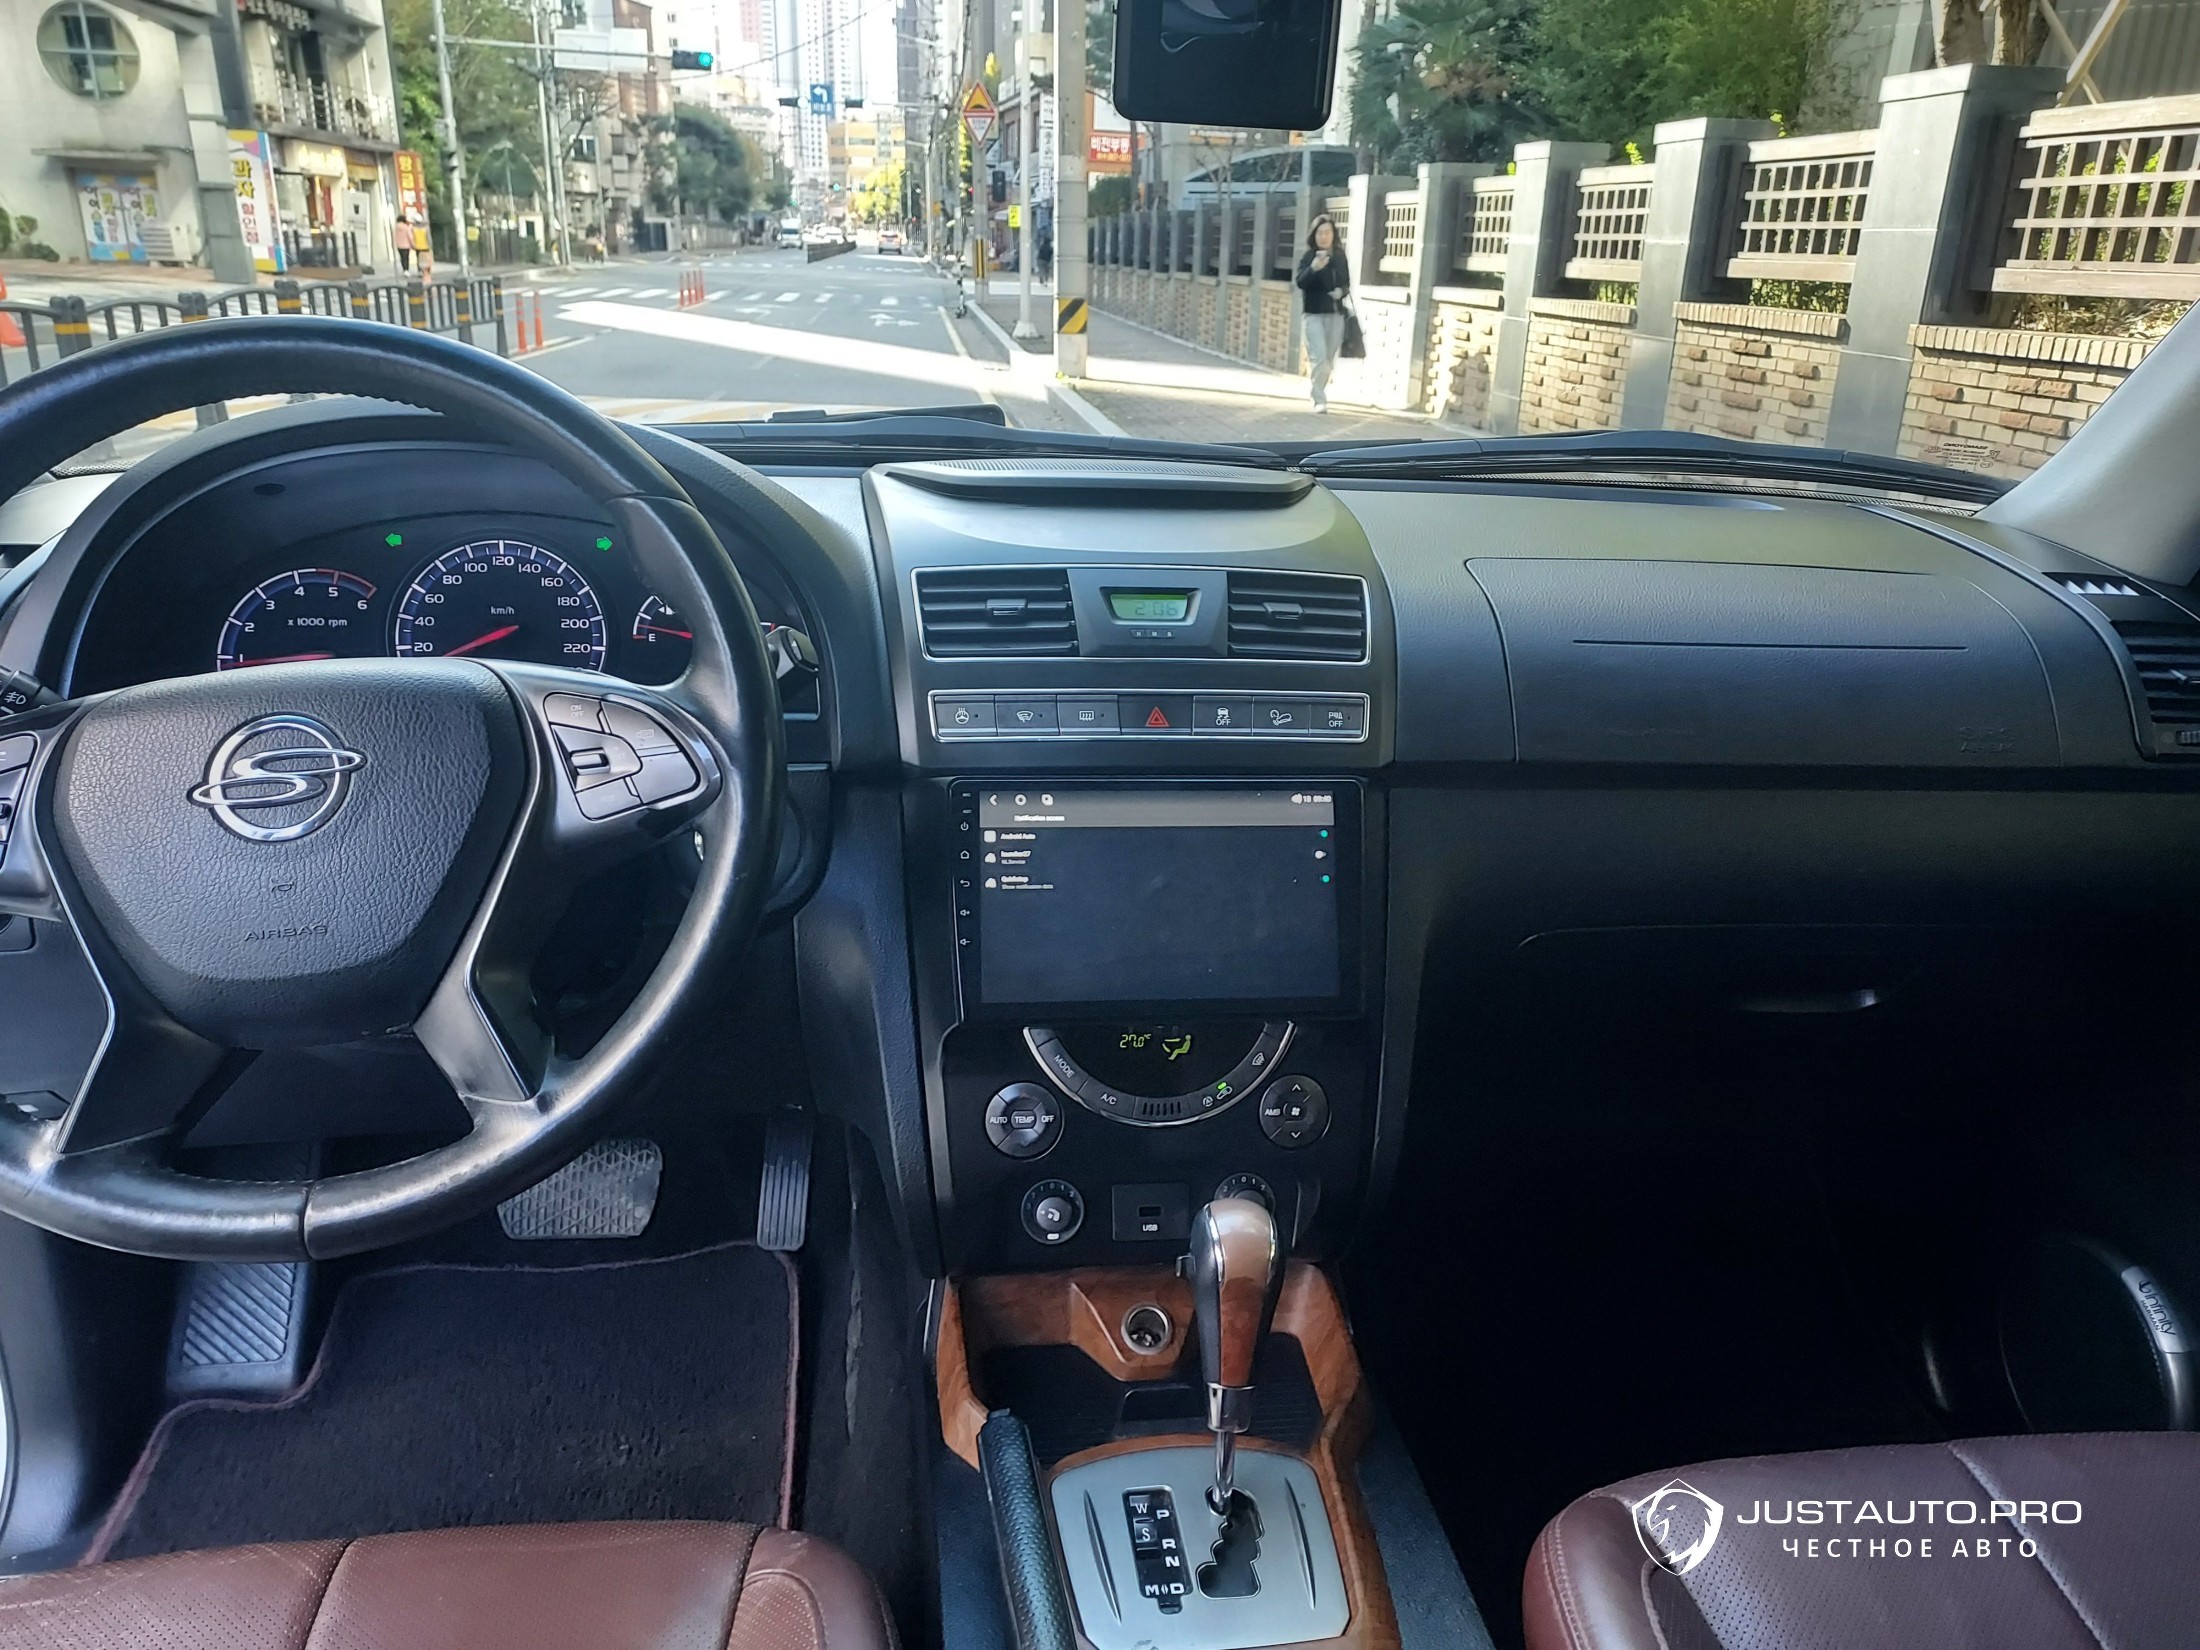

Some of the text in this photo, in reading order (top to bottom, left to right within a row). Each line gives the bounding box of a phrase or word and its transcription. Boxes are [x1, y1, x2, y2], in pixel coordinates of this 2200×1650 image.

[492, 556, 515, 566] 120
[464, 562, 488, 573] 100
[518, 563, 542, 573] 140
[442, 574, 463, 585] 80
[541, 577, 564, 587] 160
[294, 586, 305, 597] 4
[328, 586, 339, 597] 5
[424, 593, 445, 604] 60
[557, 596, 580, 606] 180
[265, 600, 276, 610] 3
[357, 600, 368, 610] 6
[490, 606, 515, 615] km/h
[244, 622, 255, 632] 2
[297, 617, 325, 626] 1000
[328, 618, 348, 628] rpm
[414, 616, 435, 627] 40
[560, 618, 590, 629] 200
[648, 633, 656, 642] E
[413, 642, 434, 652] 20
[563, 643, 591, 653] 220
[1215, 718, 1232, 726] OFF
[1328, 720, 1344, 728] OFF
[244, 925, 328, 942] AIRBAG
[1053, 1054, 1075, 1079] MODE
[1100, 1092, 1117, 1105] A/C
[989, 1116, 1008, 1124] AUTO
[1014, 1116, 1035, 1124] TEMP
[1041, 1115, 1055, 1124] OFF
[1136, 1503, 1148, 1514] W
[1156, 1509, 1170, 1520] P
[1141, 1527, 1151, 1542] S
[1161, 1538, 1177, 1550] R
[1164, 1555, 1180, 1567] N
[1144, 1582, 1185, 1596] M D
